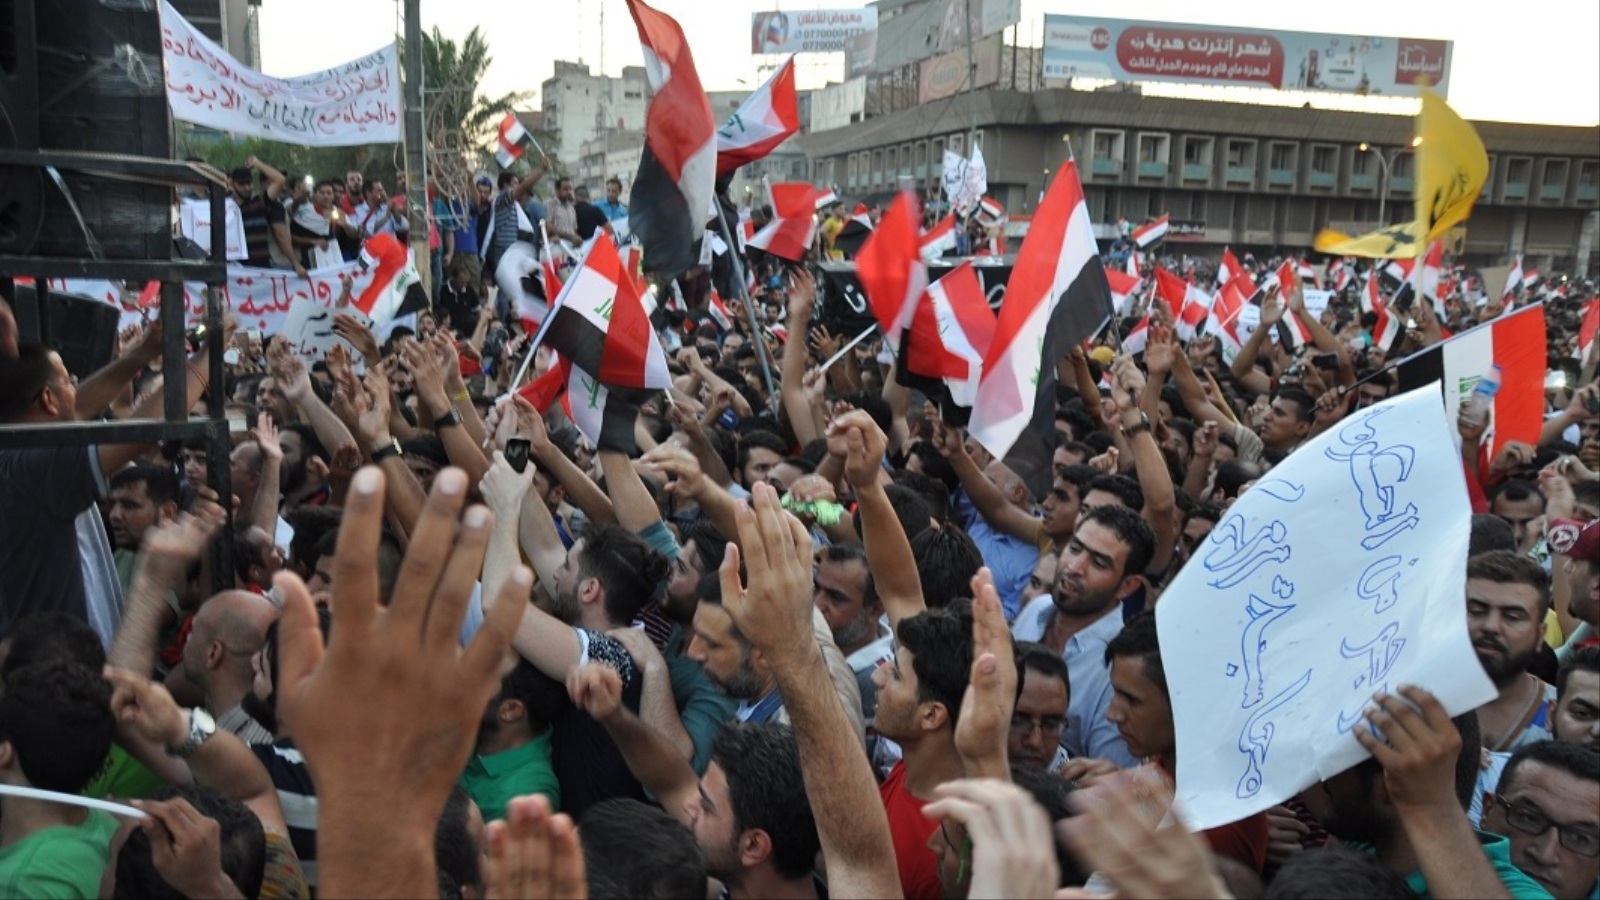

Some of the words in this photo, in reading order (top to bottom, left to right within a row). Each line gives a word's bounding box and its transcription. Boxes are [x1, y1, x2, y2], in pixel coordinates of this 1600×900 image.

[827, 12, 863, 25] معروض
[1145, 31, 1185, 53] هدية
[1188, 36, 1234, 58] إنترنت
[1234, 38, 1272, 58] شهر
[1243, 61, 1271, 78] أجهزة
[1357, 555, 1419, 614] من
[1226, 575, 1313, 799] محاسبة
